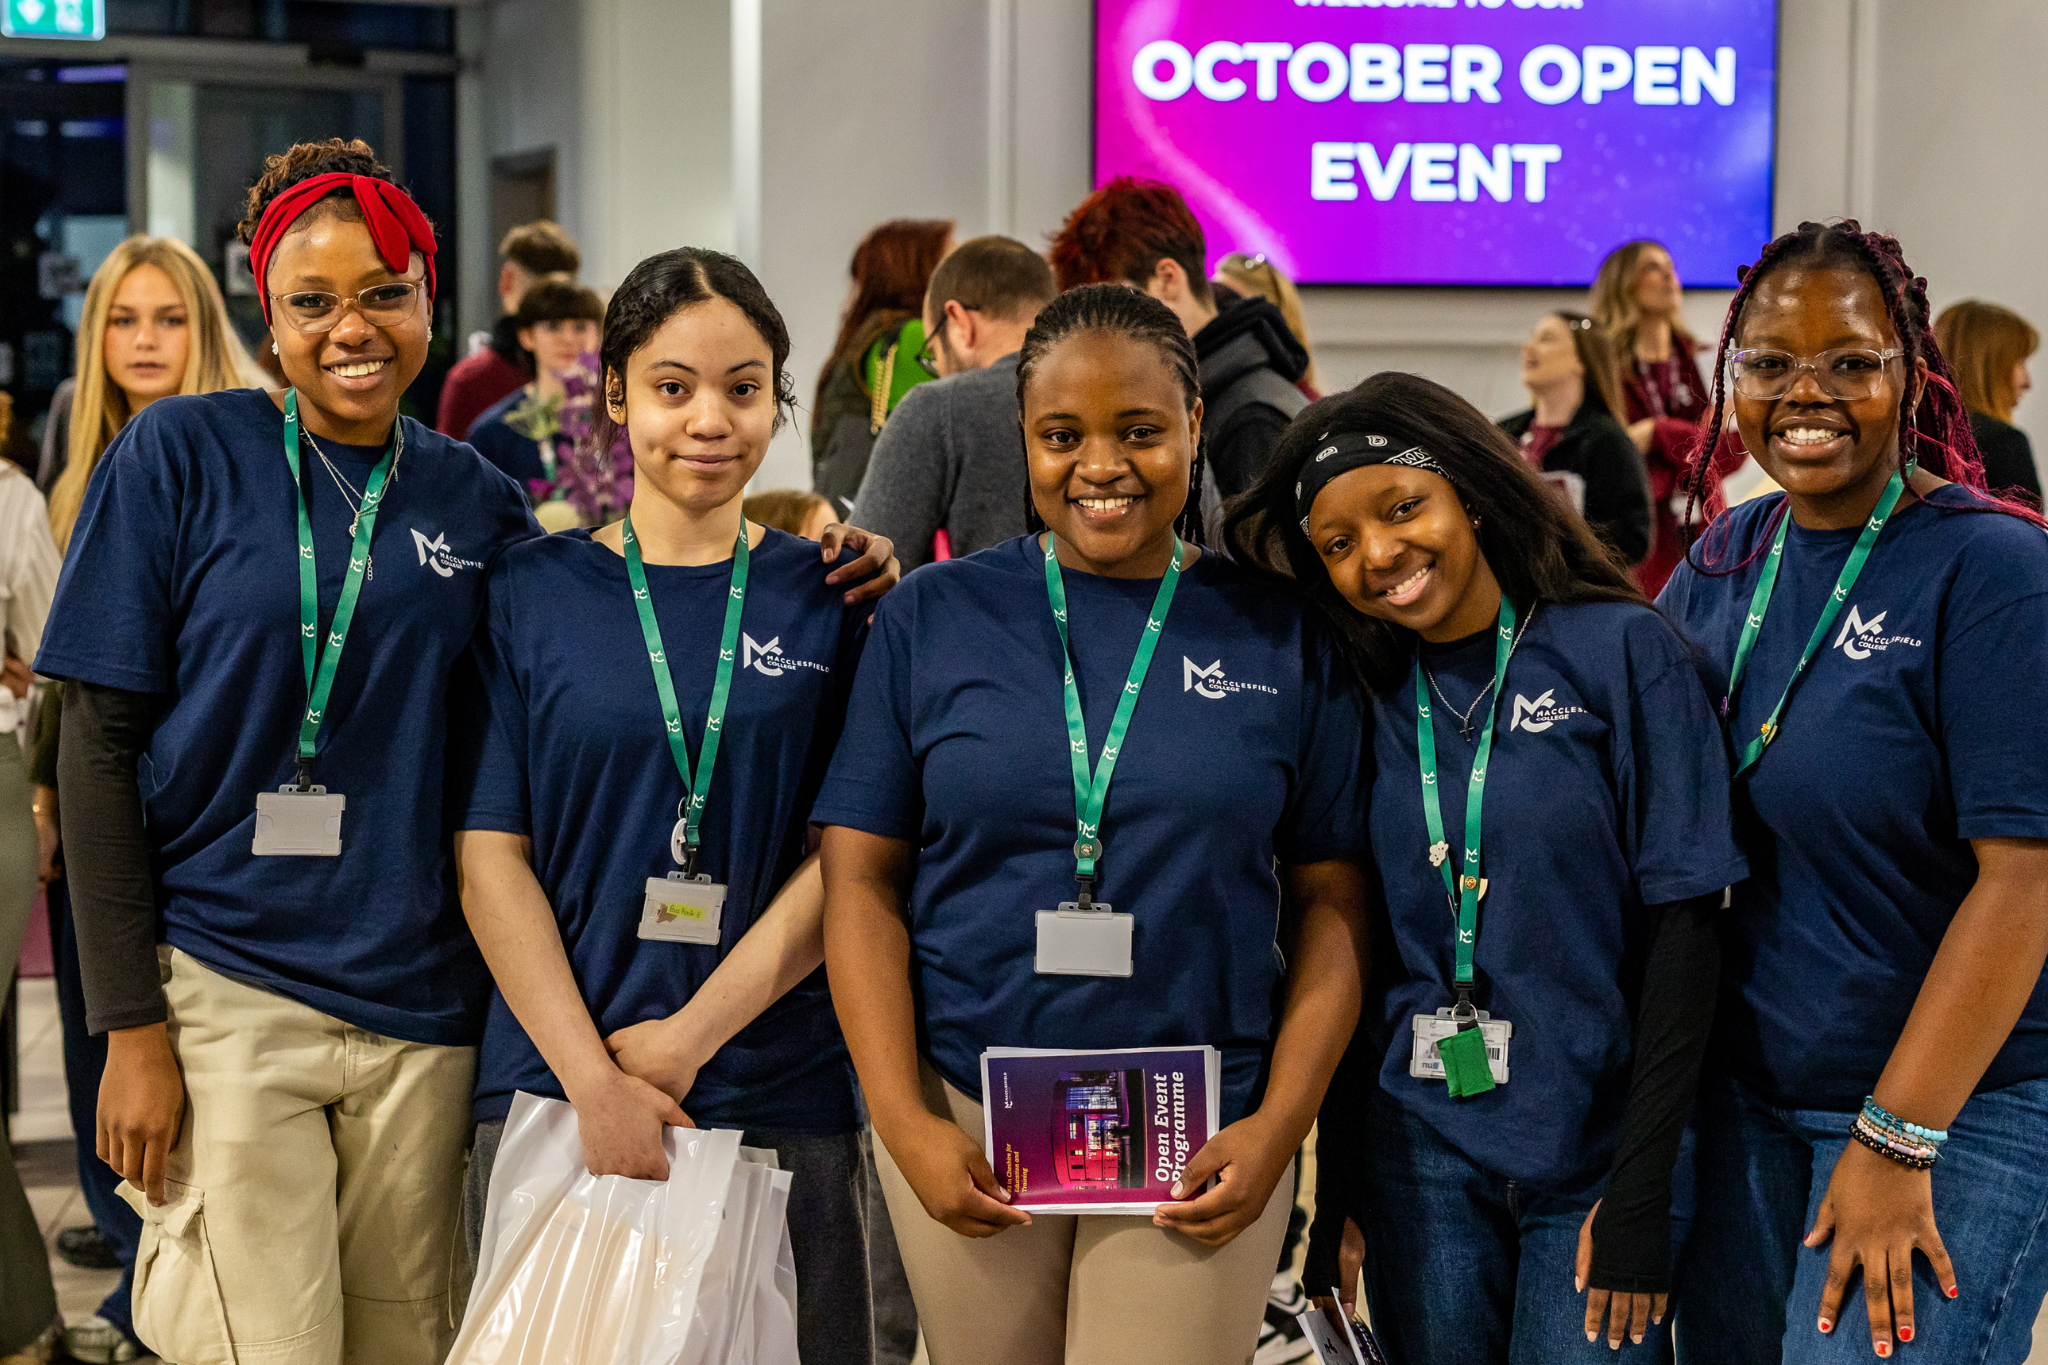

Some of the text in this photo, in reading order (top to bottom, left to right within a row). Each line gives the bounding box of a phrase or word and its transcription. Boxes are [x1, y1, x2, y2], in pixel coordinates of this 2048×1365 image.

[1132, 39, 1737, 106] OCTOBER OPEN
[1310, 141, 1563, 203] EVENT
[1858, 641, 1888, 651] COLLEGE
[766, 655, 830, 673] MACCLESFIELD
[767, 661, 797, 671] COLLEGE
[1208, 678, 1278, 695] MACCLESFIELD
[1208, 684, 1240, 692] COLLEGE
[1535, 713, 1570, 722] COLLEGE
[669, 904, 681, 913] Bus
[1153, 1073, 1173, 1182] Open Event
[1172, 1071, 1190, 1182] Programme
[1005, 1143, 1013, 1153] for
[1021, 1167, 1029, 1193] Training
